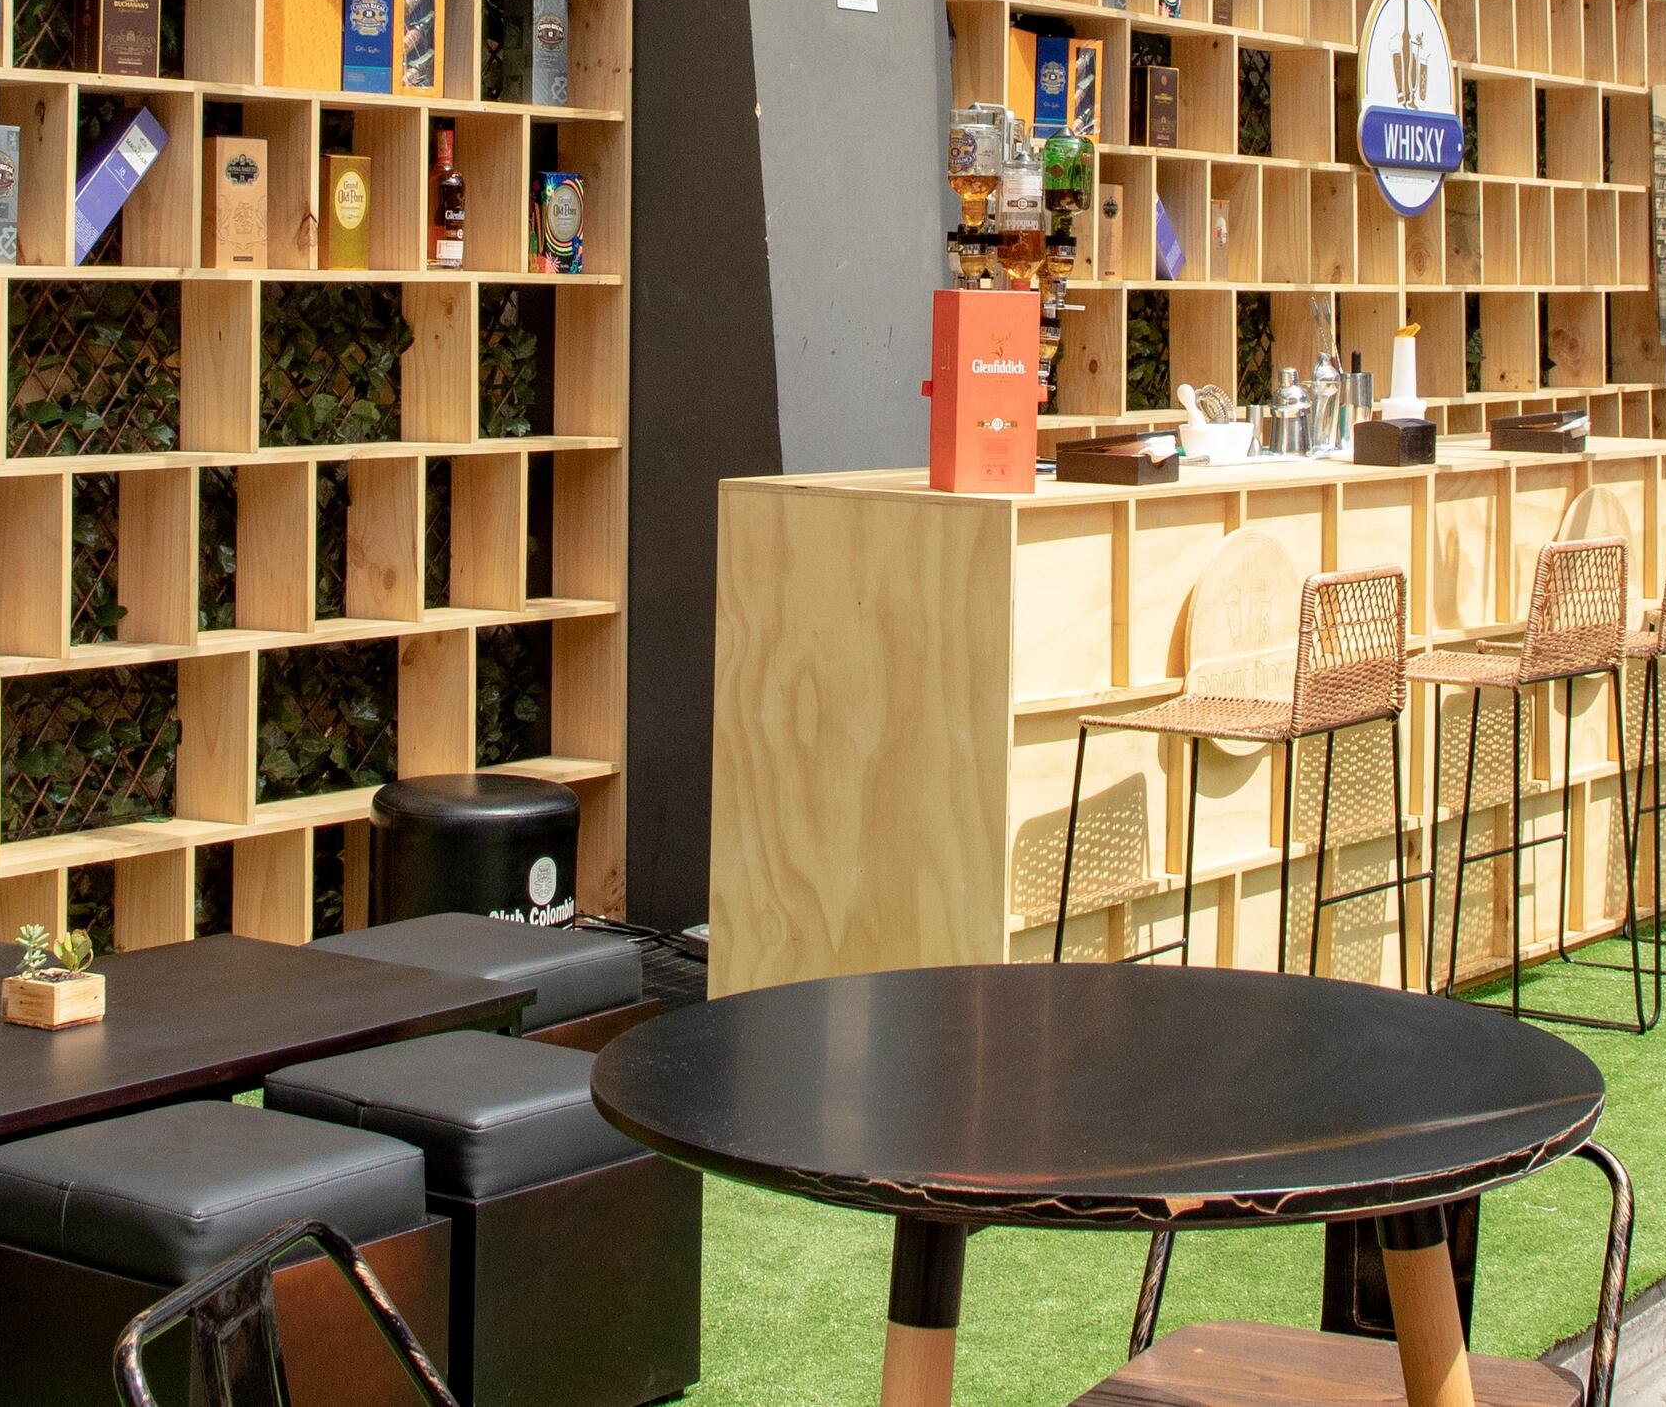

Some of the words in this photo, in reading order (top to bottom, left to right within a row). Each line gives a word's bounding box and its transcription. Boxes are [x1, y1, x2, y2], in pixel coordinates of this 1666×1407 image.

[1383, 122, 1445, 164] WHISKY
[971, 359, 1026, 375] Glenfiddich
[1254, 658, 1295, 697] POIN
[529, 896, 574, 927] Colombi
